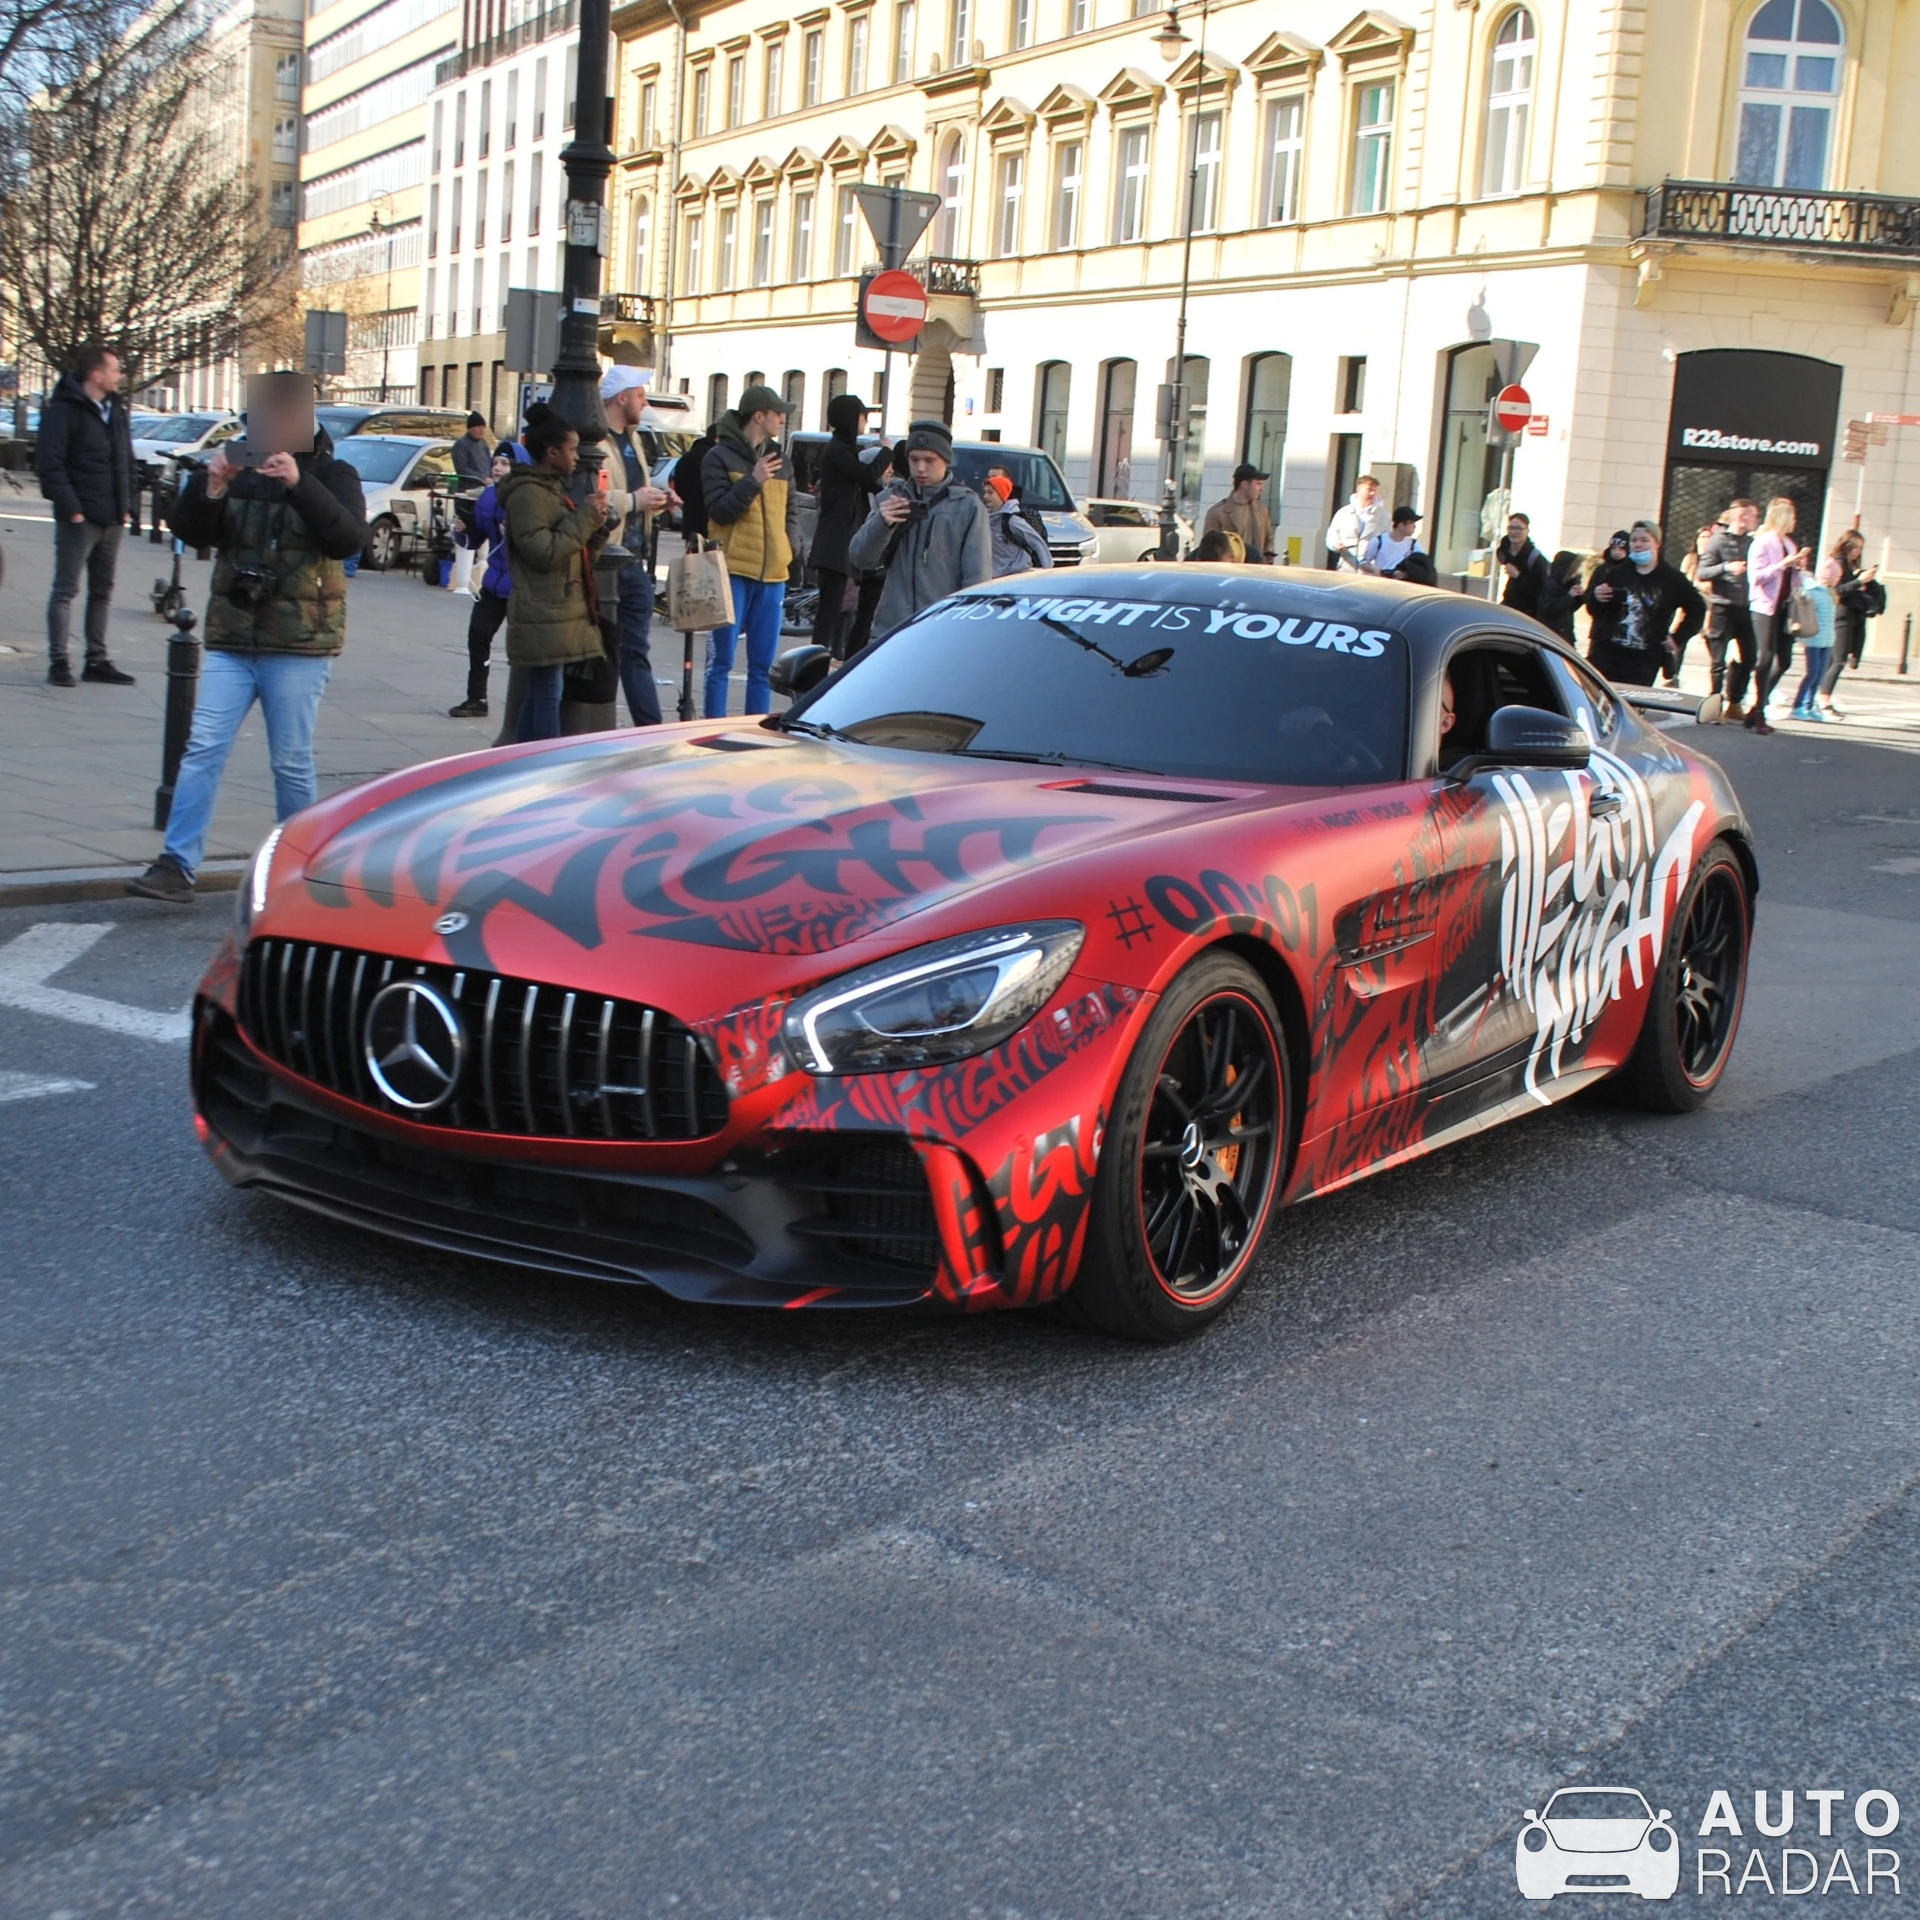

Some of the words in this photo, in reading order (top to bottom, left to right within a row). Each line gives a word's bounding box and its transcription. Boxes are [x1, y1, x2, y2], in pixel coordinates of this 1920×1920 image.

[1682, 427, 1820, 456] R23store.com
[996, 597, 1159, 628] NIGHT
[1150, 604, 1201, 631] IS
[1203, 609, 1392, 658] YOURS
[1106, 868, 1319, 960] #00:01
